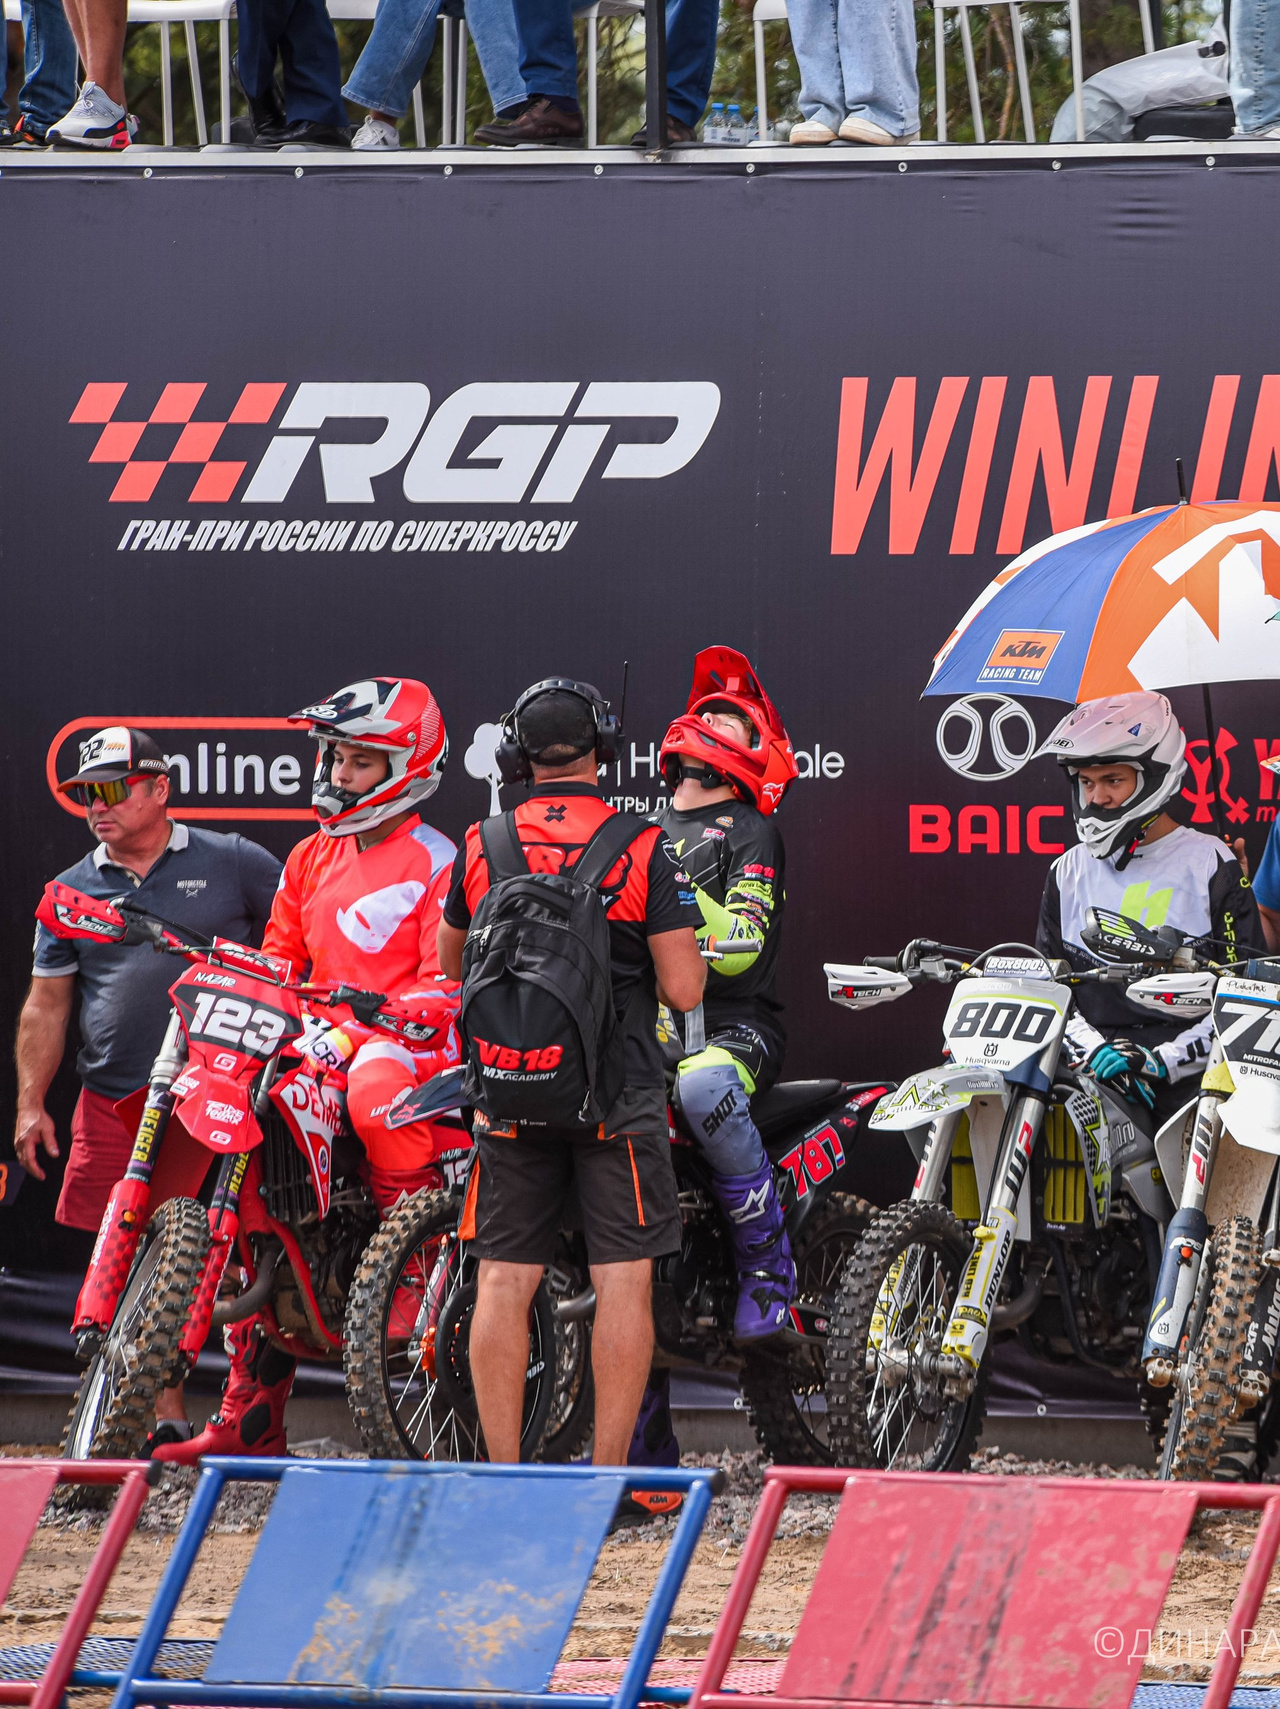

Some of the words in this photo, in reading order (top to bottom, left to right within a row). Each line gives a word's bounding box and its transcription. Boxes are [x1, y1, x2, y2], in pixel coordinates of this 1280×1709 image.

[241, 381, 721, 503] RGP
[117, 520, 248, 551] ГРАН-ПРИ
[250, 520, 351, 551] РОССИИ
[350, 521, 395, 551] ПО
[398, 520, 577, 552] СУПЕРКРОССУ
[1000, 640, 1049, 660] KTM
[982, 668, 1015, 680] RACING
[1017, 669, 1042, 682] TEAM
[908, 804, 1065, 854] BAIC
[188, 991, 286, 1056] 123
[949, 1001, 1057, 1044] 800
[472, 1036, 564, 1072] VB18
[965, 1055, 1011, 1067] Husqvarna
[369, 1103, 392, 1119] UF
[701, 1088, 740, 1139] SHOT
[443, 1159, 471, 1187] 12
[778, 1124, 846, 1201] 787
[985, 1229, 1011, 1311] DUNLOP
[1243, 1320, 1260, 1363] FXR
